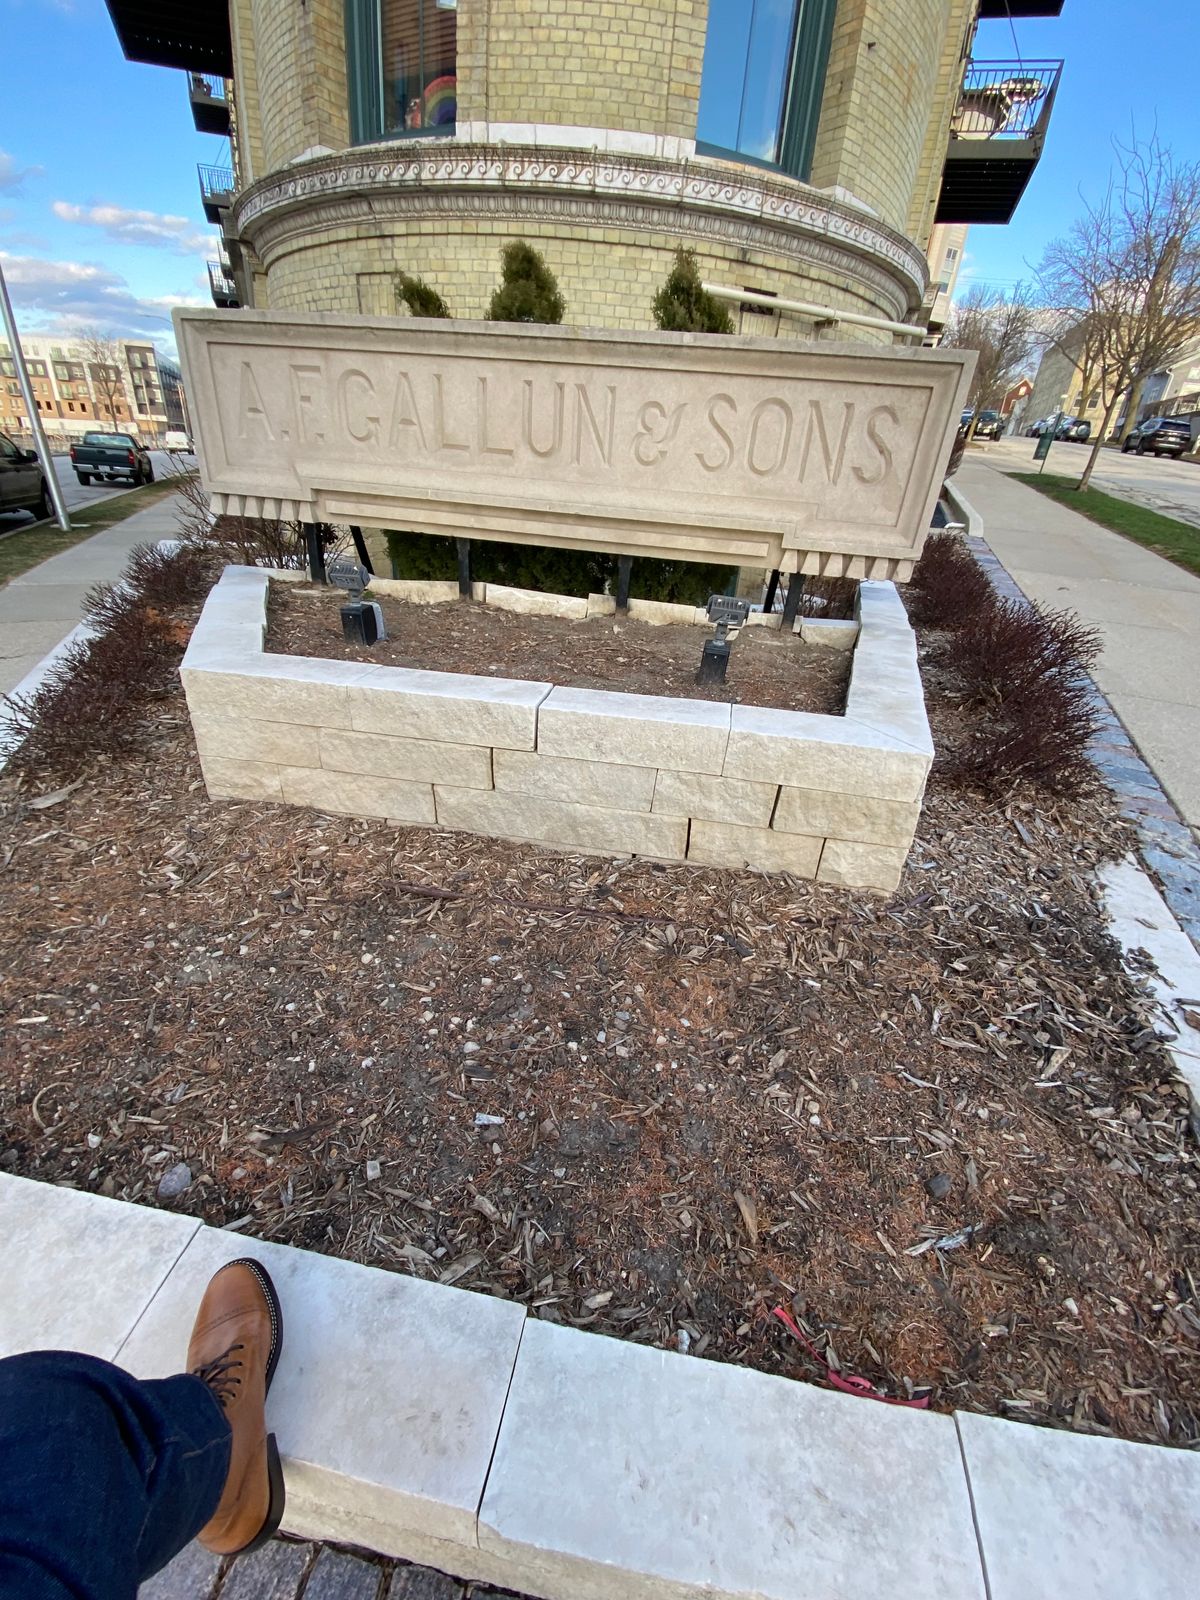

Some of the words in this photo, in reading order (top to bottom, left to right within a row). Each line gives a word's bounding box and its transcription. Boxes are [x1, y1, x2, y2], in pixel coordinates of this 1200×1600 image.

[337, 368, 616, 467] GALLUN
[632, 400, 688, 467] &
[694, 392, 900, 486] SONS
